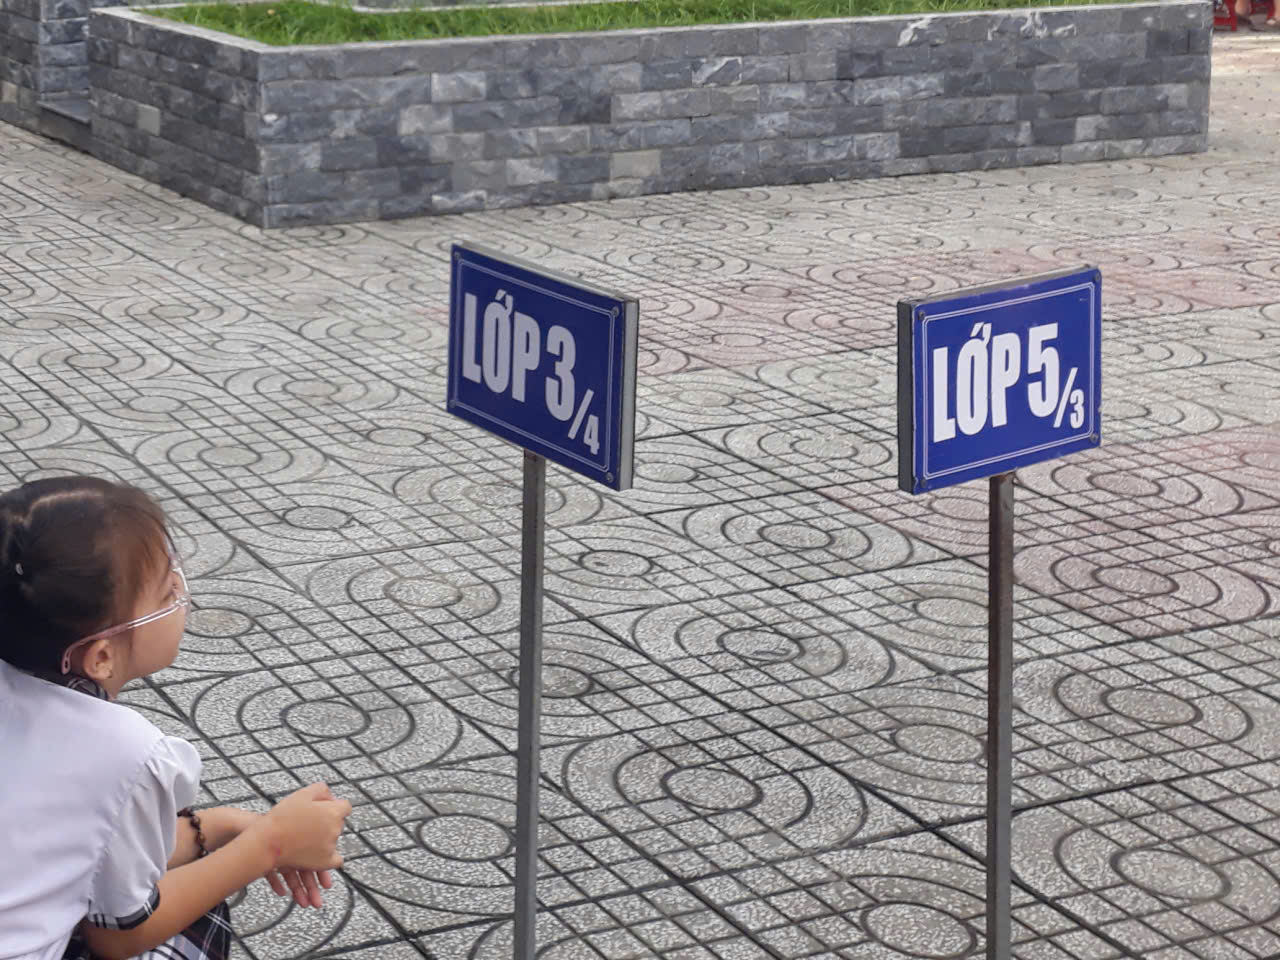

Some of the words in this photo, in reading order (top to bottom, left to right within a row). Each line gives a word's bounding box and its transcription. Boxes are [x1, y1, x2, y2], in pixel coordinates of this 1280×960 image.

[462, 289, 541, 403] LỚP
[545, 324, 600, 456] 3/4
[933, 321, 1021, 444] LỚP
[1027, 322, 1085, 429] 5/3
